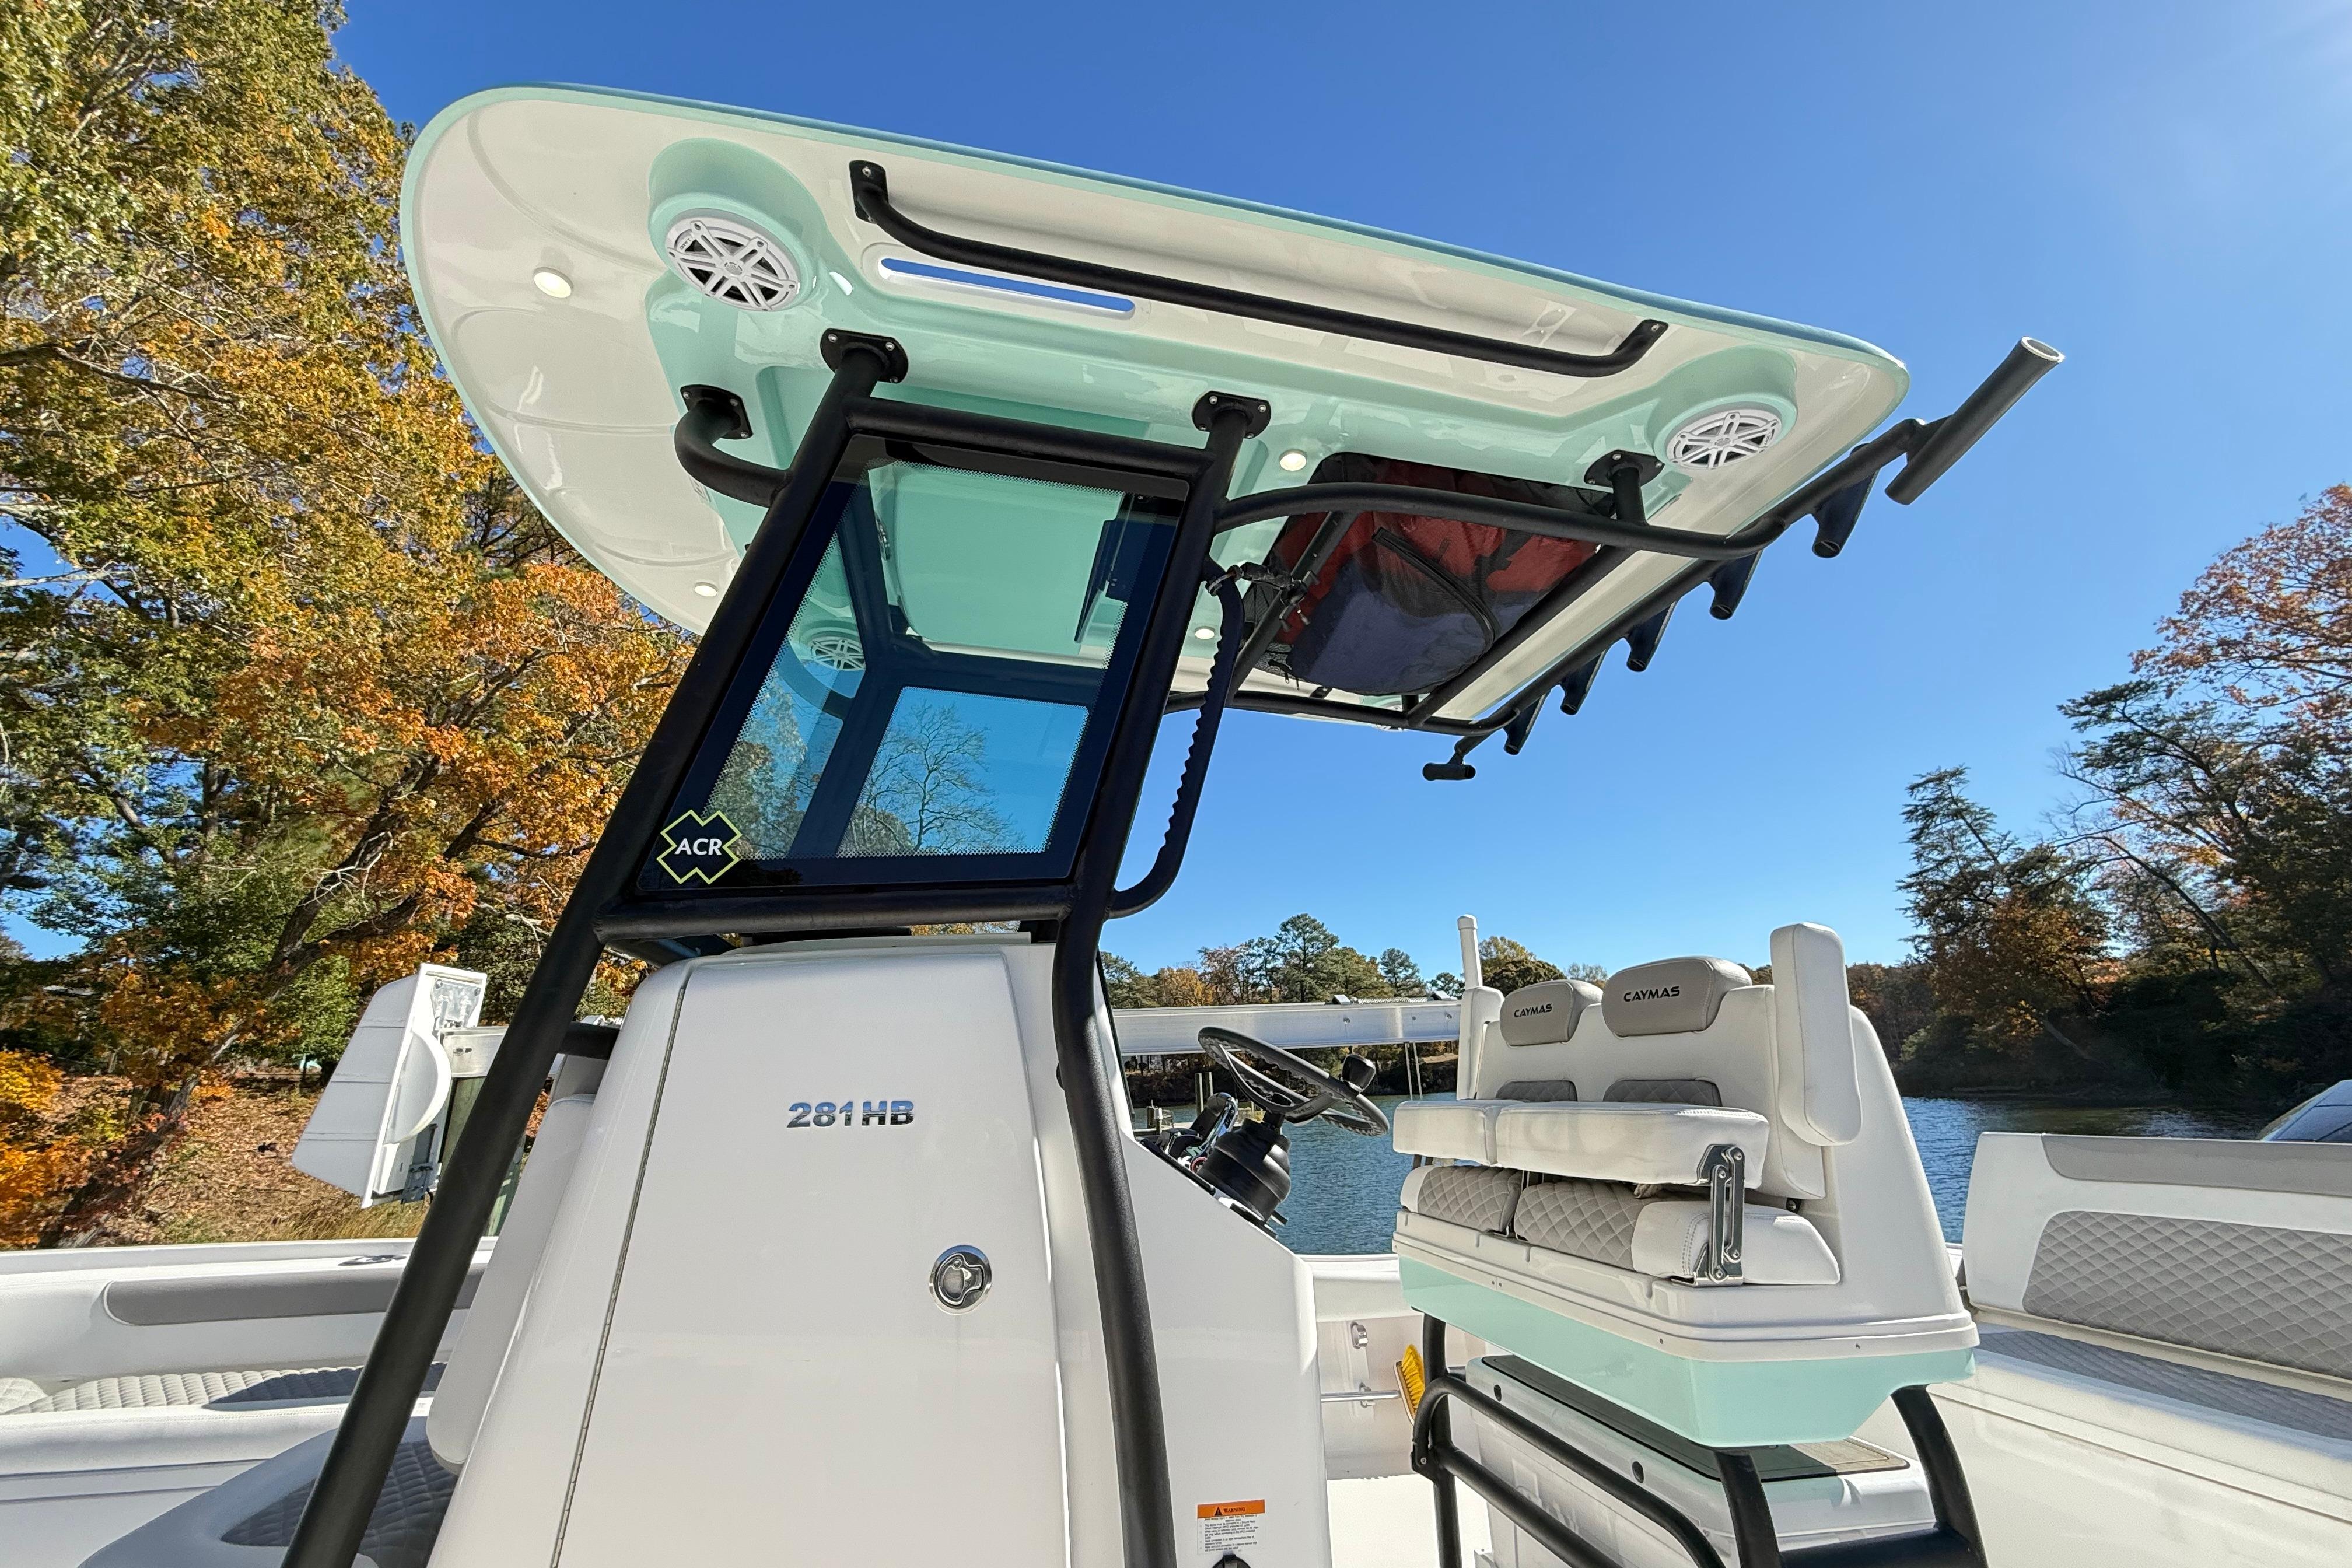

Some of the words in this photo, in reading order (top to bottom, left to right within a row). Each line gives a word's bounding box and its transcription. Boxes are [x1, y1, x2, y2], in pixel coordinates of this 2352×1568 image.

[674, 838, 722, 856] ACR
[1623, 986, 1680, 1002] CAYMAS
[1514, 1003, 1552, 1018] CAYMAS
